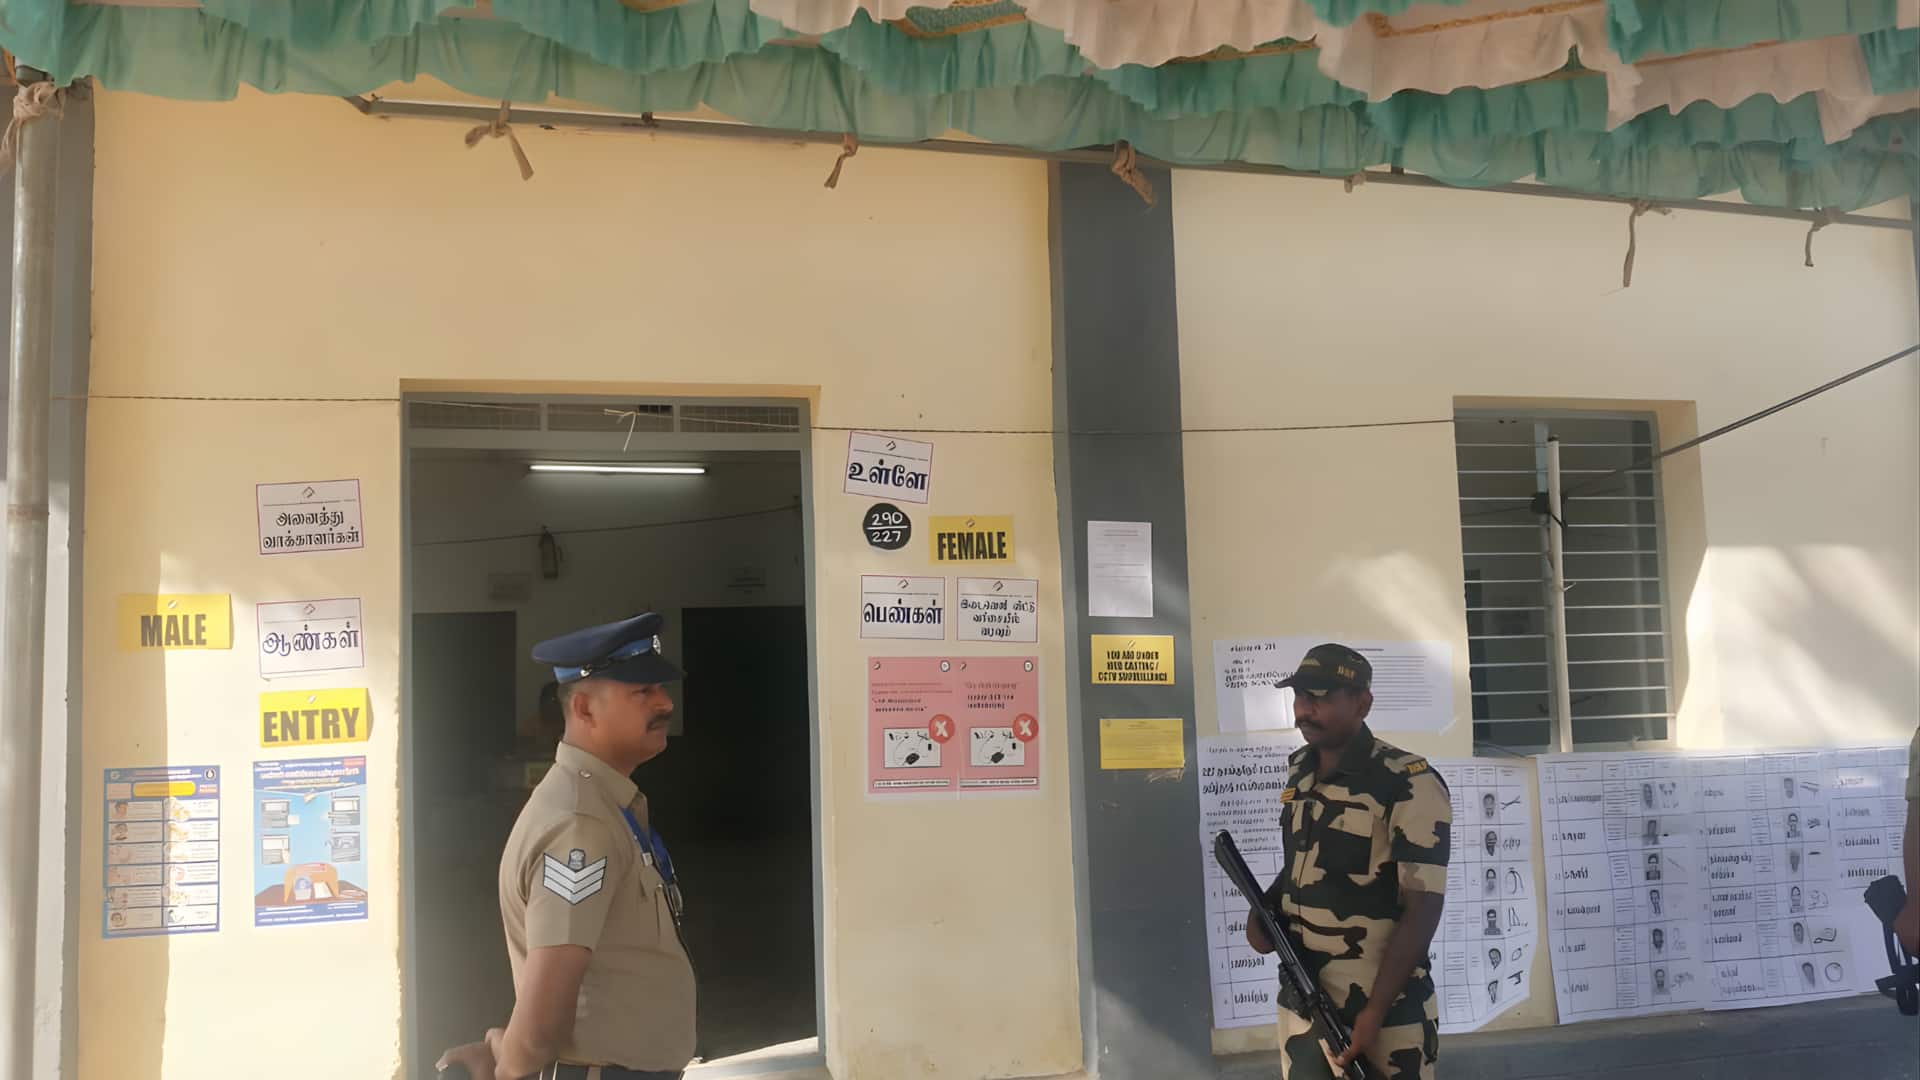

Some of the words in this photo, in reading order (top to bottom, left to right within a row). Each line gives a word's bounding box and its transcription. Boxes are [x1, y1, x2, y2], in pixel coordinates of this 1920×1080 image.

[848, 458, 929, 490] உள்ளே
[276, 506, 344, 527] அனைத்து
[871, 511, 903, 526] 290
[263, 526, 359, 548] வாக்காளர்கள்
[872, 530, 902, 543] 227
[937, 531, 1007, 560] FEMALE
[863, 598, 943, 625] பெண்கள்
[141, 614, 207, 647] MALE
[263, 621, 359, 656] ஆண்கள்
[263, 707, 360, 743] ENTRY
